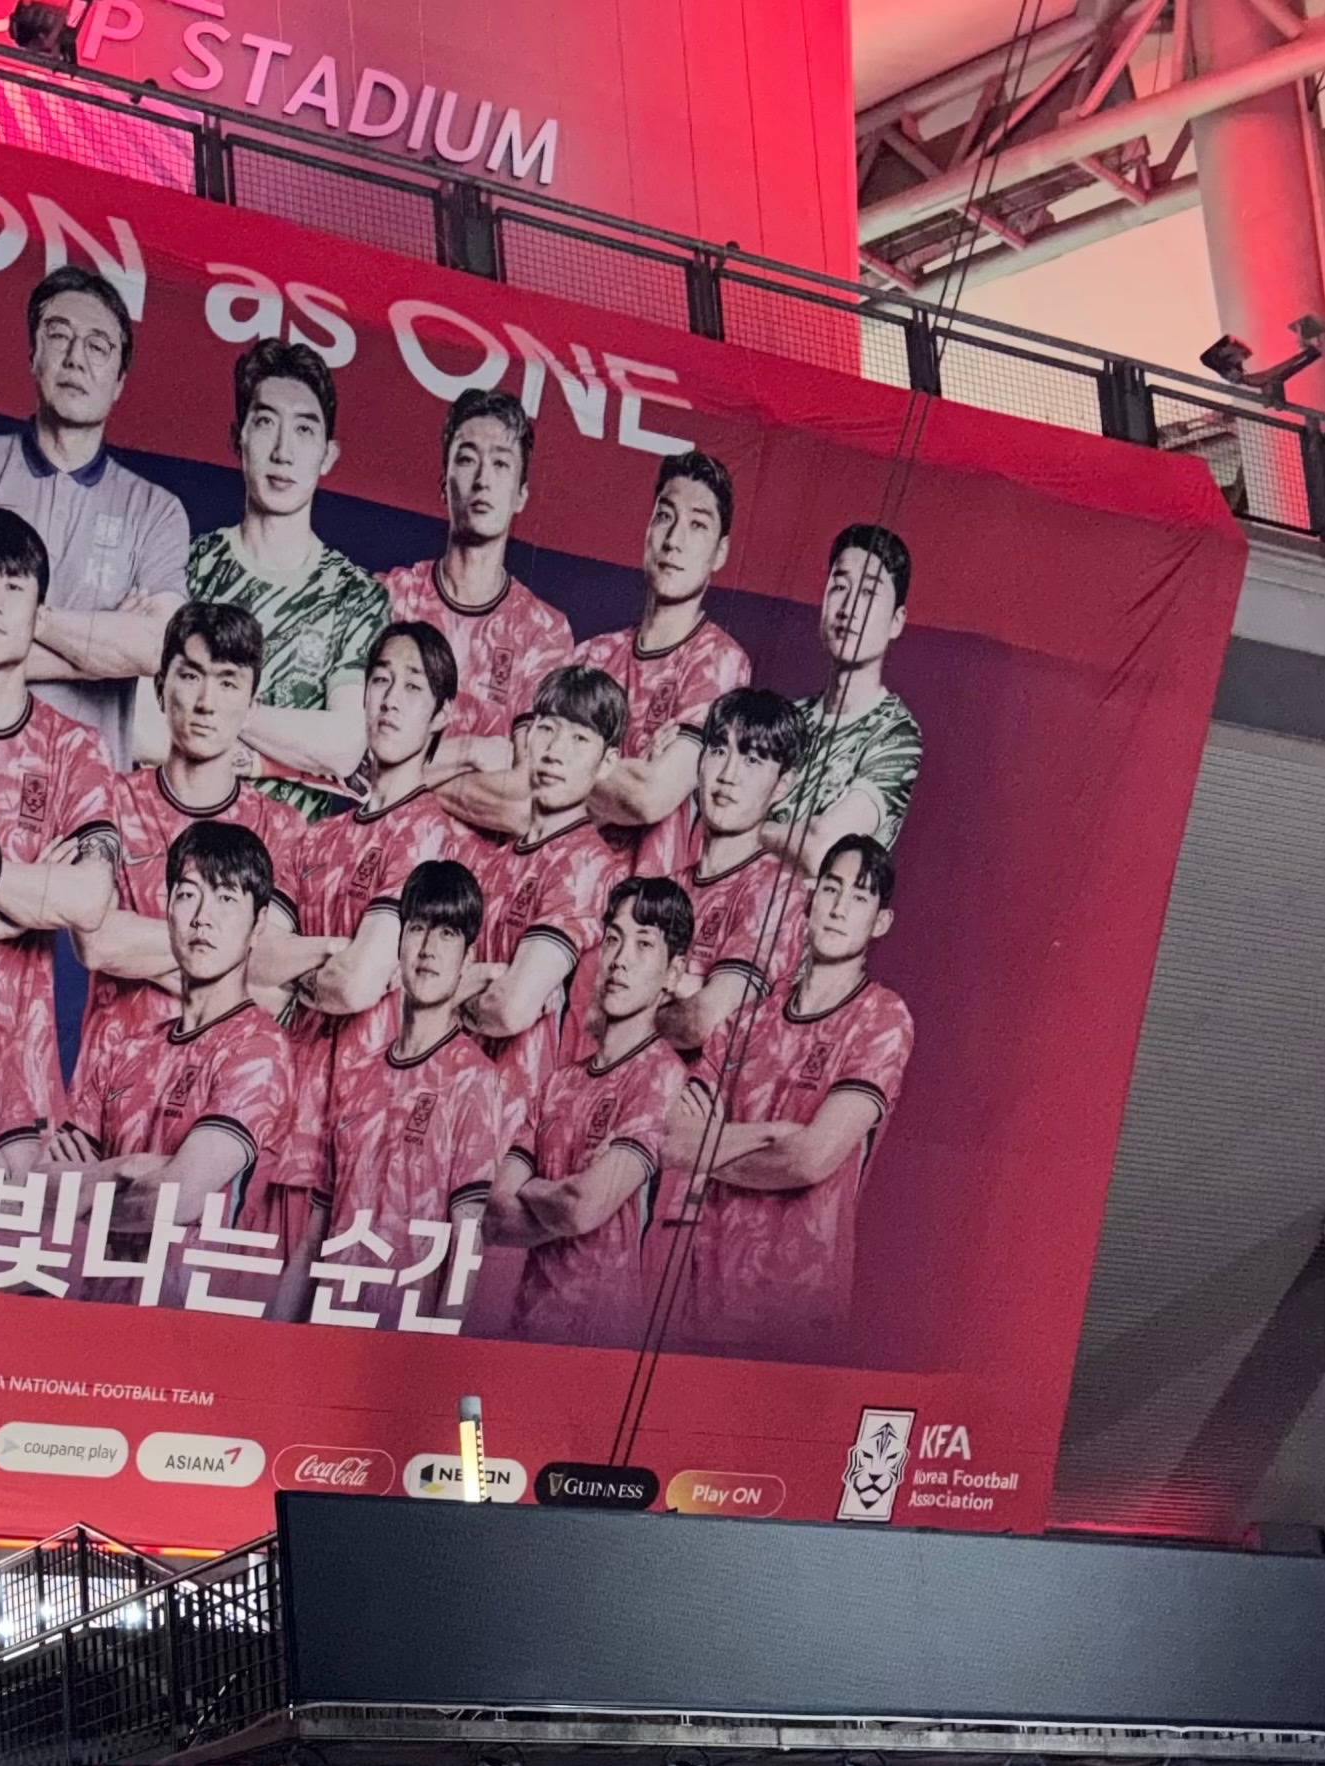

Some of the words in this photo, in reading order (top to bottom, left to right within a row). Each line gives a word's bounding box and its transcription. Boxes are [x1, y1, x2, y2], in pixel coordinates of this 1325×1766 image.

[172, 21, 558, 186] STADIUM
[205, 262, 358, 369] as
[394, 301, 696, 457] ONE
[308, 1208, 482, 1336] 순간
[9, 1376, 89, 1397] NATIONAL
[92, 1383, 168, 1402] FOOTBALL
[170, 1388, 214, 1406] TEAM
[23, 1440, 87, 1461] coupang
[87, 1443, 119, 1463] play
[919, 1424, 973, 1461] KFA
[164, 1454, 226, 1473] ASIANA
[439, 1468, 511, 1485] NEON
[912, 1469, 949, 1486] Korea
[952, 1469, 1020, 1491] Football
[563, 1478, 645, 1500] GUINNESS
[691, 1483, 730, 1505] Play
[732, 1487, 763, 1505] ON
[907, 1492, 995, 1512] Association
